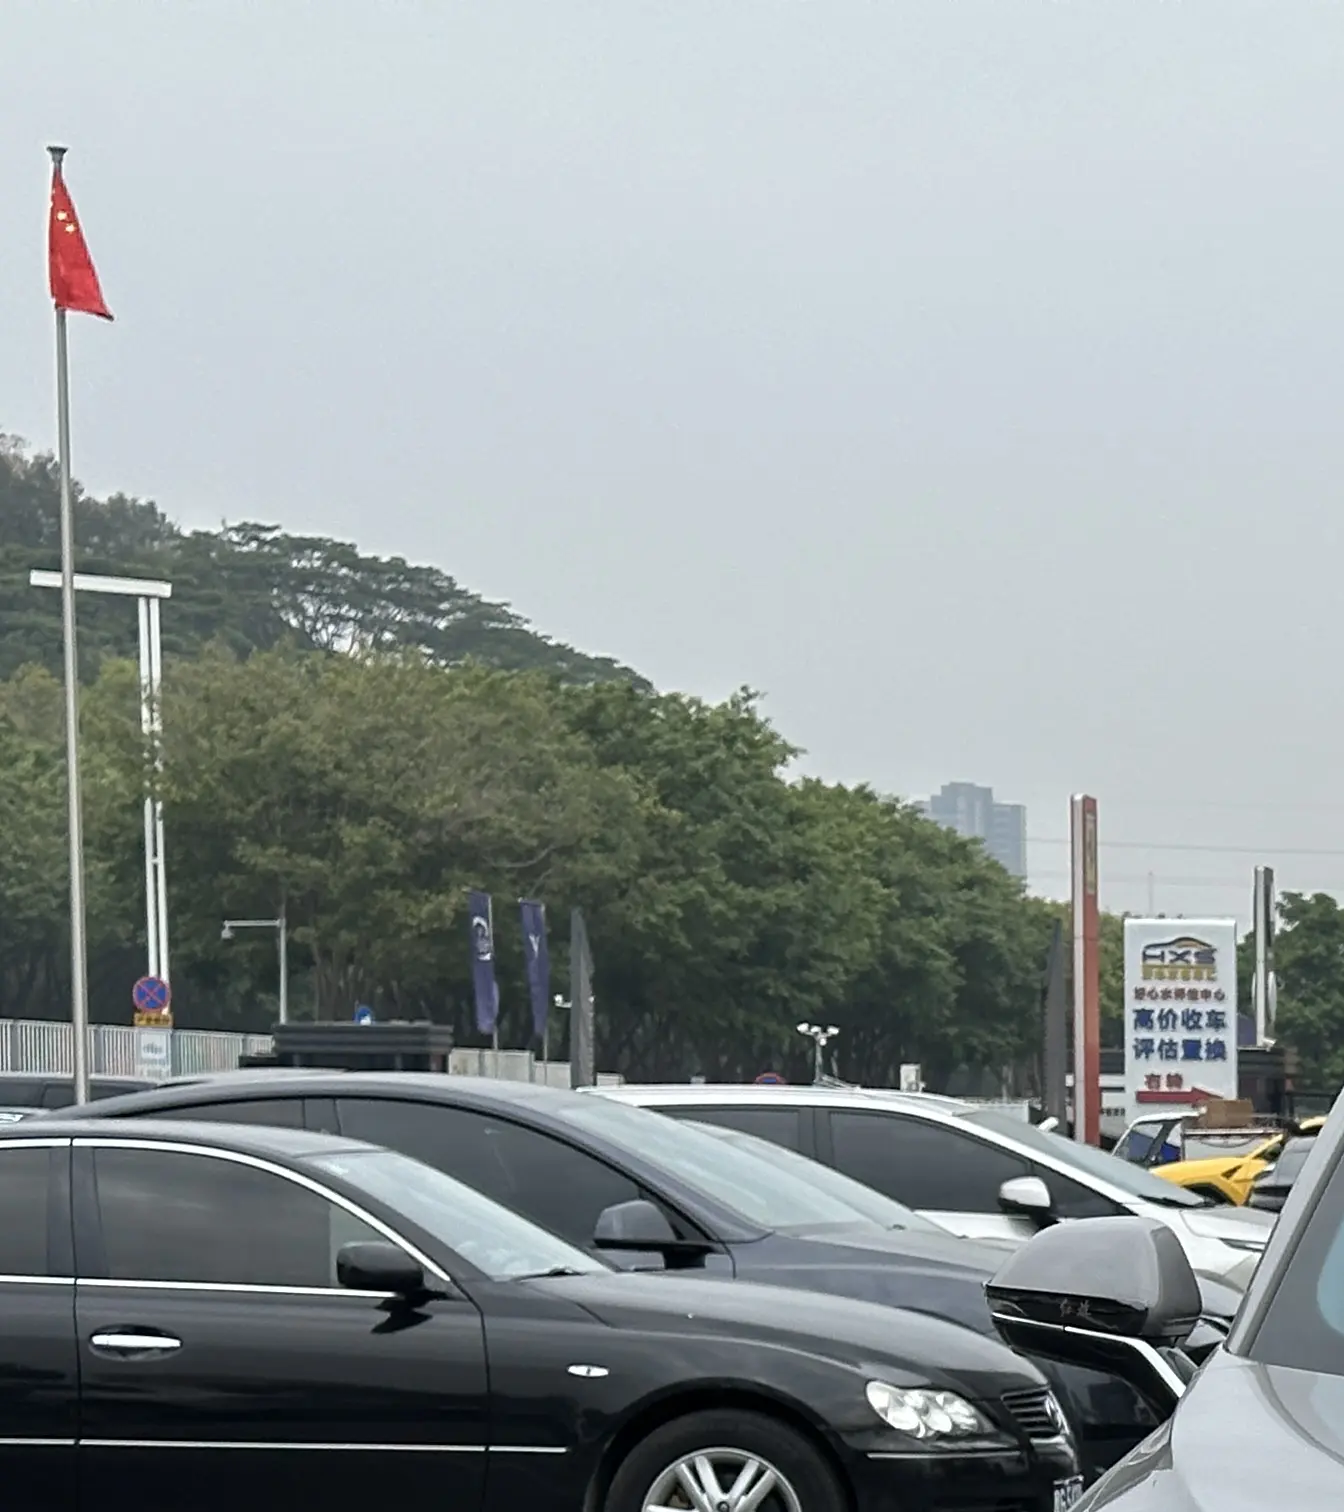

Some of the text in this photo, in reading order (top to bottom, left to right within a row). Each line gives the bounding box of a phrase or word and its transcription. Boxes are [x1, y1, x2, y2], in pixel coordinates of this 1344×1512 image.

[1132, 1007, 1227, 1032] 高价收车
[1132, 1036, 1228, 1062] 评估置换
